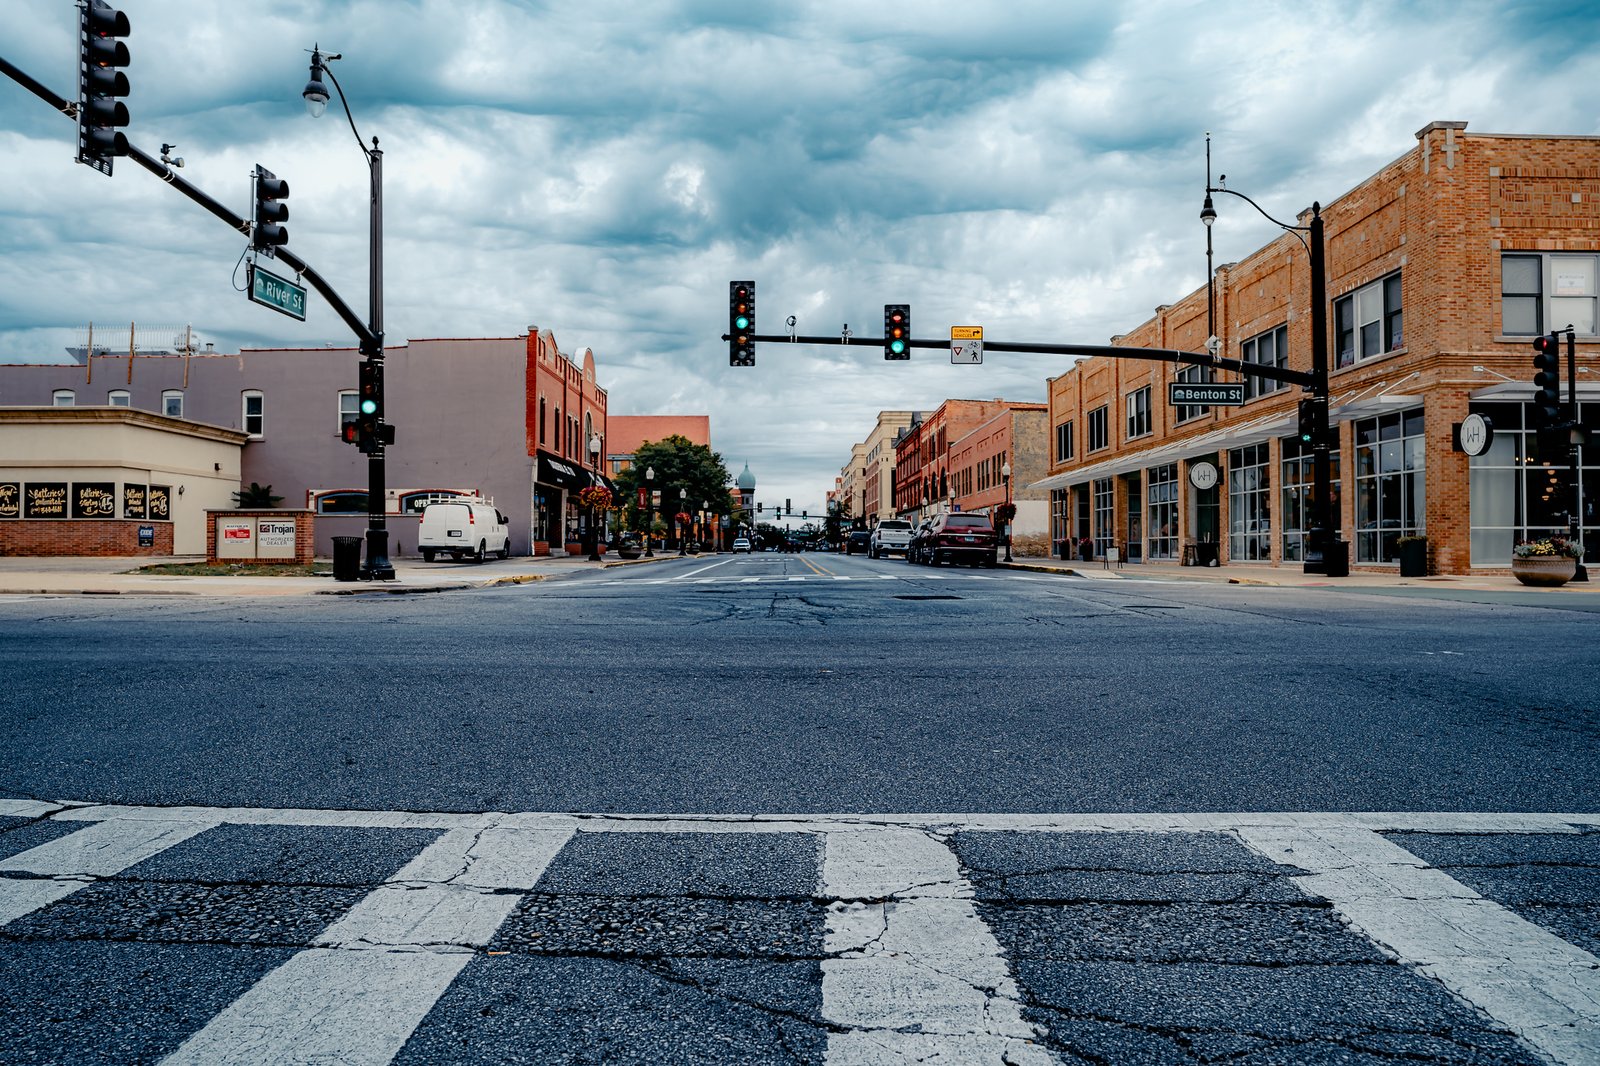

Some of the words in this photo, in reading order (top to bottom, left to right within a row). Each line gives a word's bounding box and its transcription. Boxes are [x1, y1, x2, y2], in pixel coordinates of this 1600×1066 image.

[266, 281, 291, 304] River
[292, 294, 302, 310] St
[1185, 389, 1227, 400] Benton
[1229, 389, 1241, 400] St
[271, 524, 294, 535] Trojan
